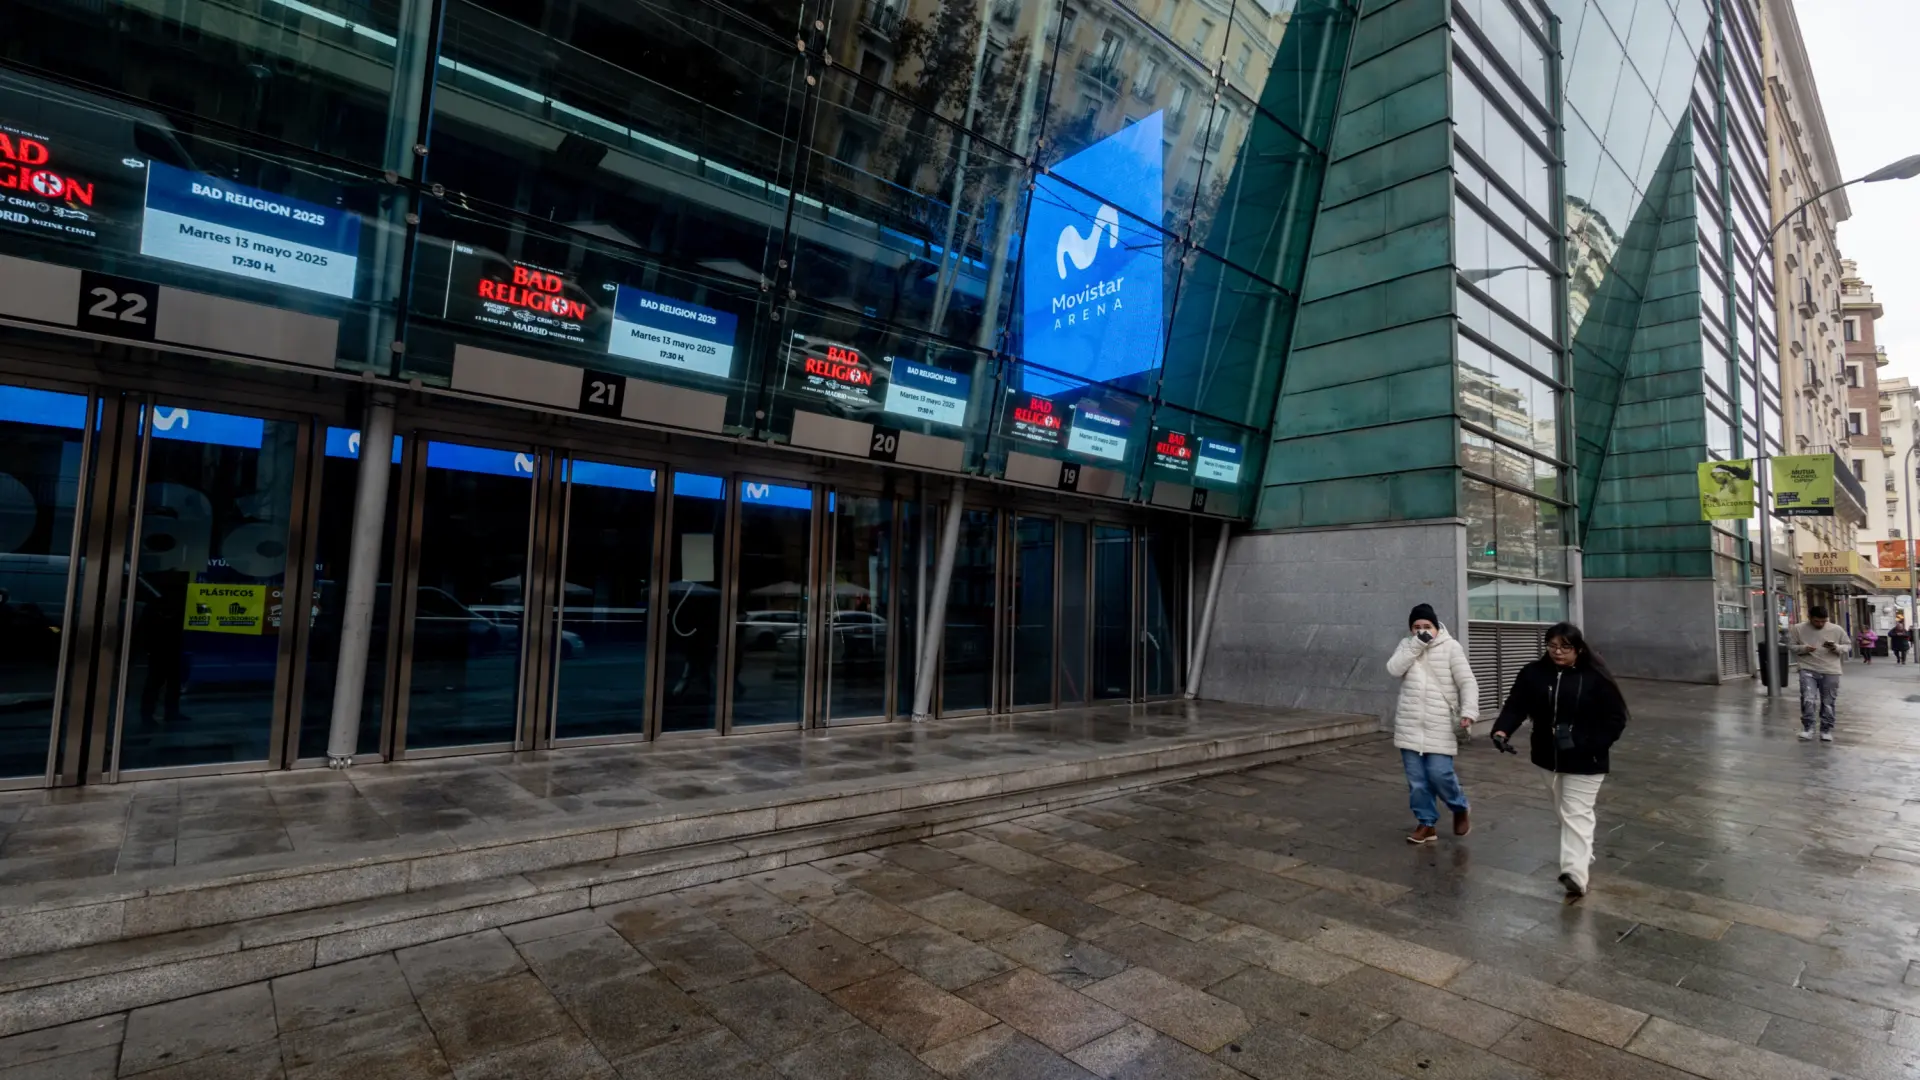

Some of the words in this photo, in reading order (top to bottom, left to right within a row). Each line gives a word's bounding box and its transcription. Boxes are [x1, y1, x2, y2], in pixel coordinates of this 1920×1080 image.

[192, 183, 222, 202] BAD
[225, 189, 291, 218] RELIGION
[293, 206, 326, 226] 2025
[32, 218, 63, 230] WIZINK
[65, 226, 97, 238] CENTER
[180, 222, 231, 248] Martes
[235, 234, 250, 249] 13
[252, 241, 292, 258] mayo
[295, 249, 328, 268] 2025
[232, 256, 262, 271] 17:30
[264, 260, 276, 274] H.
[513, 266, 563, 294] BAD
[478, 278, 587, 320] RELIGION
[1052, 276, 1125, 314] Movistar
[88, 286, 148, 325] 22
[640, 298, 658, 310] BAD
[660, 303, 697, 320] RELIGION
[698, 314, 716, 324] 2025
[1054, 298, 1122, 330] ARENA
[512, 322, 548, 336] MADRID
[631, 328, 661, 343] Martes
[662, 336, 670, 345] 13
[672, 340, 695, 351] mayo
[696, 344, 716, 356] 2025
[660, 350, 677, 360] 17:30
[827, 346, 859, 366] BAD
[805, 358, 873, 386] RELIGION
[907, 366, 918, 376] BAD
[920, 369, 944, 381] RELIGION
[944, 376, 957, 384] 2025
[590, 381, 616, 406] 21
[900, 390, 919, 401] Martes
[926, 397, 941, 406] mayo
[942, 400, 955, 409] 2025
[1030, 397, 1052, 414] BAD
[1014, 408, 1060, 430] RELIGION
[873, 434, 896, 453] 20
[1168, 433, 1185, 446] BAD
[1064, 468, 1076, 484] 19
[1194, 493, 1204, 506] 18
[1814, 552, 1838, 560] BAR
[1805, 566, 1848, 574] TORREZNOS
[200, 588, 254, 598] PLÁSTICOS
